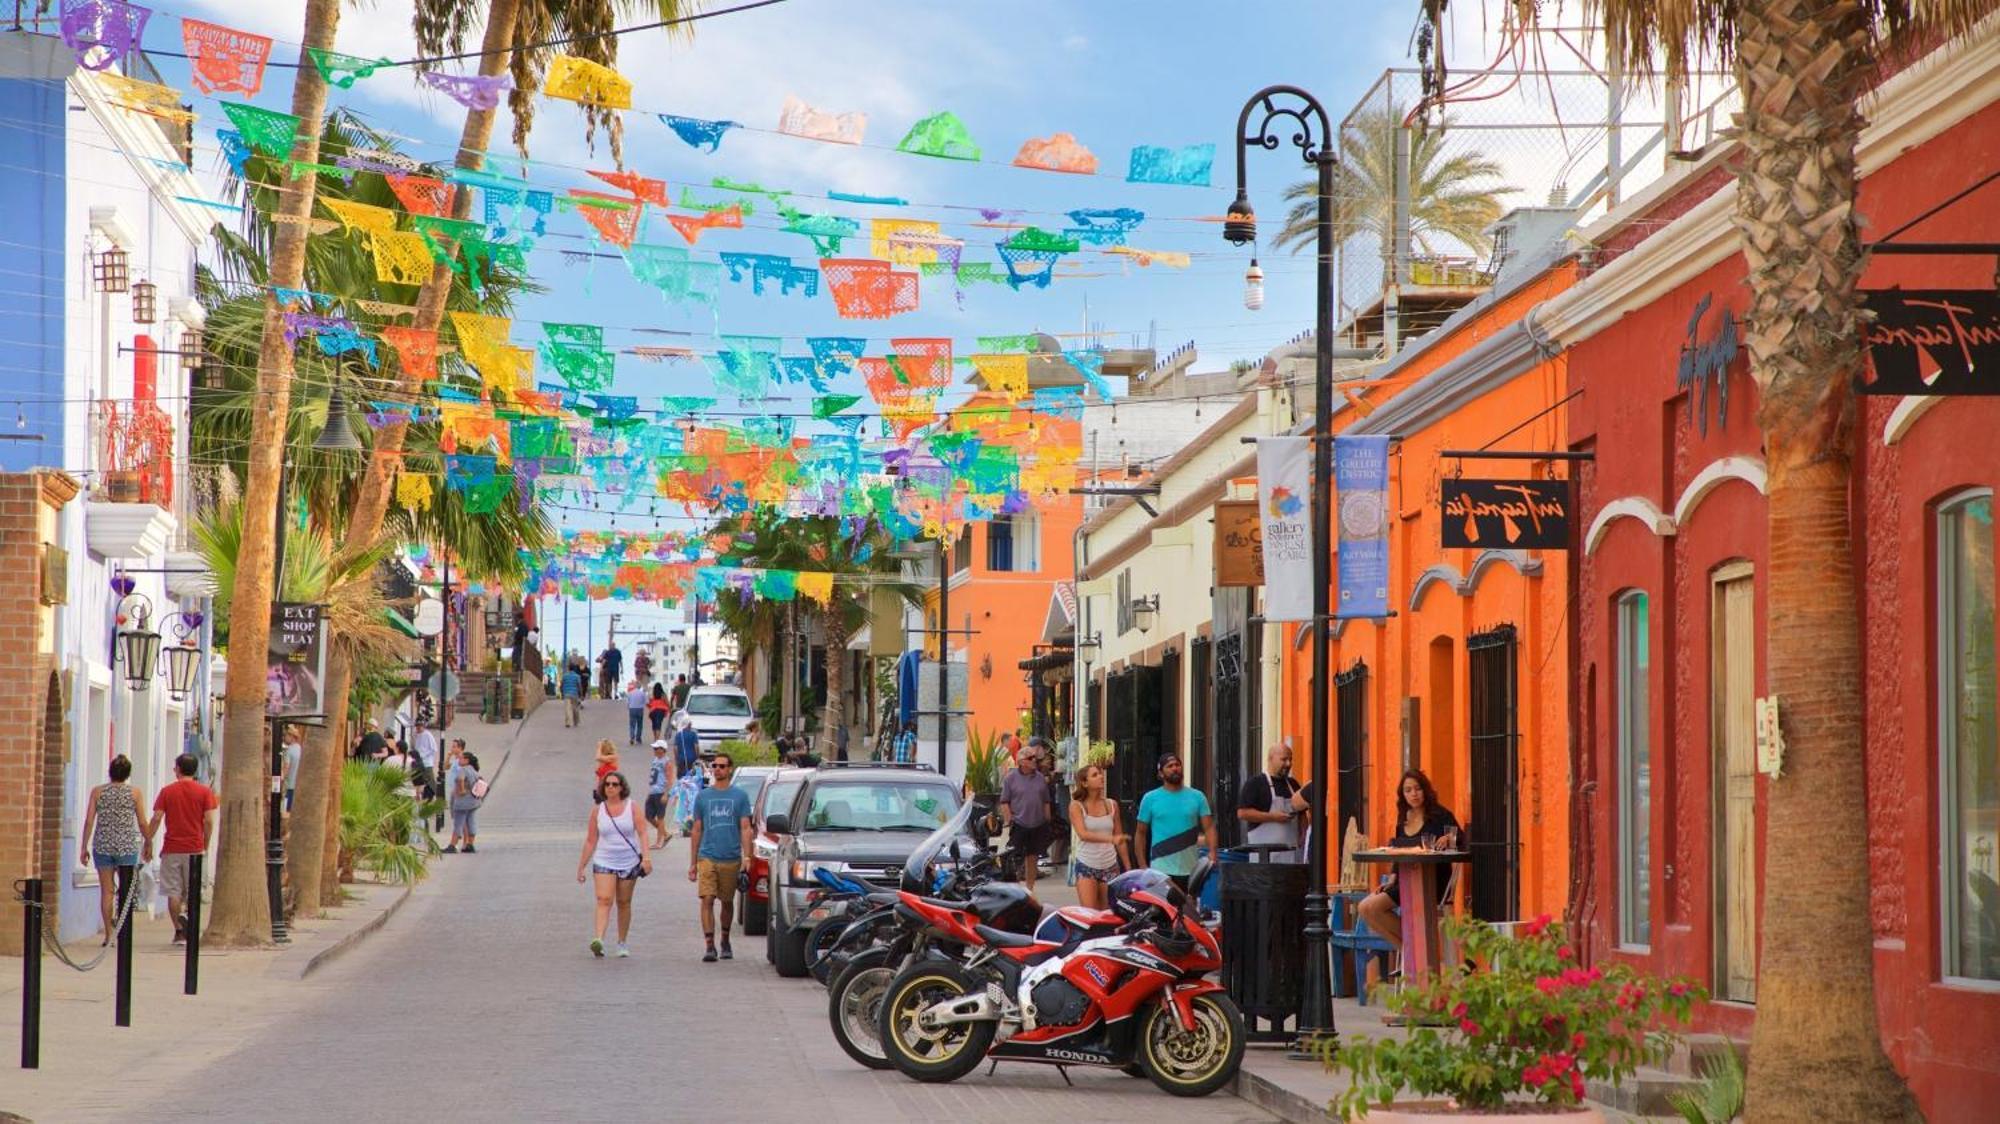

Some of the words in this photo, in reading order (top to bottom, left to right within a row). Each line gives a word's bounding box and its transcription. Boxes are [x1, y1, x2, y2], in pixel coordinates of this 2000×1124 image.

[1353, 448, 1376, 458] THE
[284, 607, 316, 619] EAT
[282, 621, 316, 632] SHOP
[282, 634, 315, 645] PLAY
[1045, 1047, 1111, 1064] HONDA
